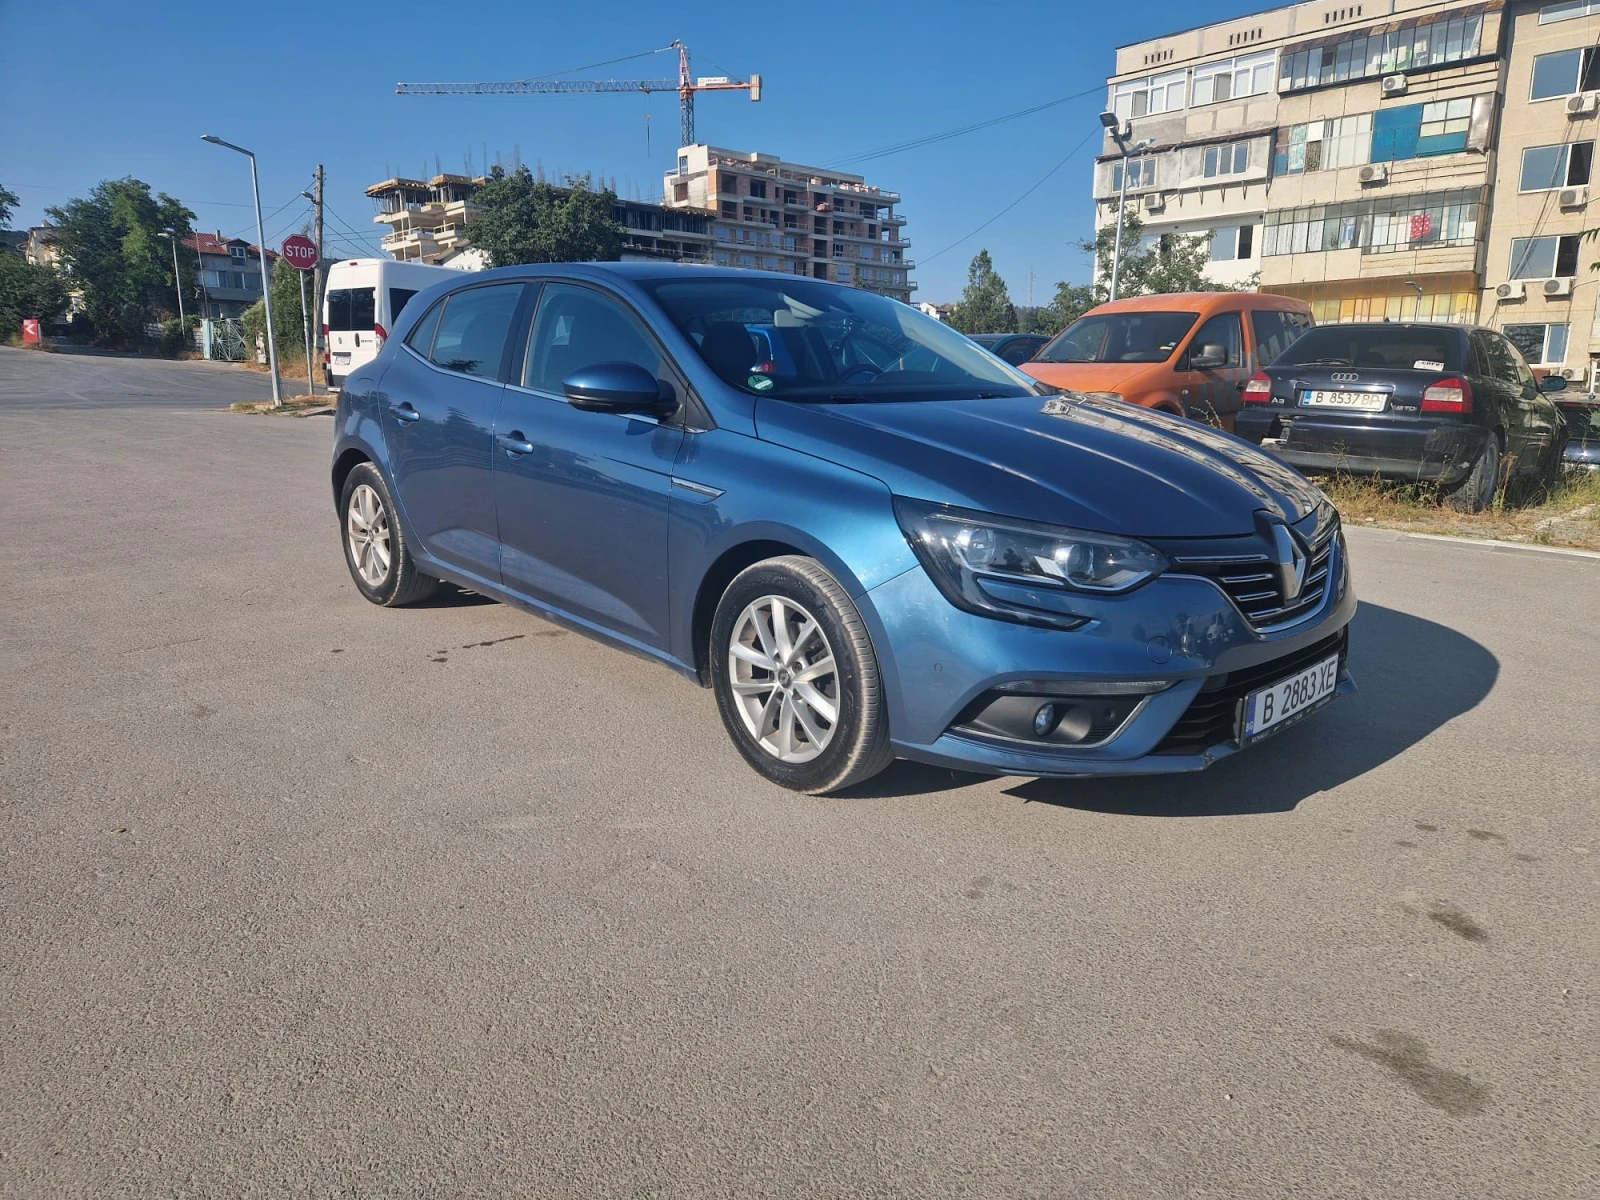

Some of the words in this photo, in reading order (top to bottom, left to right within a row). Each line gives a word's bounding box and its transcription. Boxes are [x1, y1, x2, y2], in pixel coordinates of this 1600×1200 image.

[285, 245, 315, 258] STOP
[1315, 391, 1323, 403] B
[1329, 392, 1360, 405] 8537
[1263, 692, 1274, 725] B
[1281, 671, 1317, 715] 2883
[1318, 660, 1336, 695] XE
